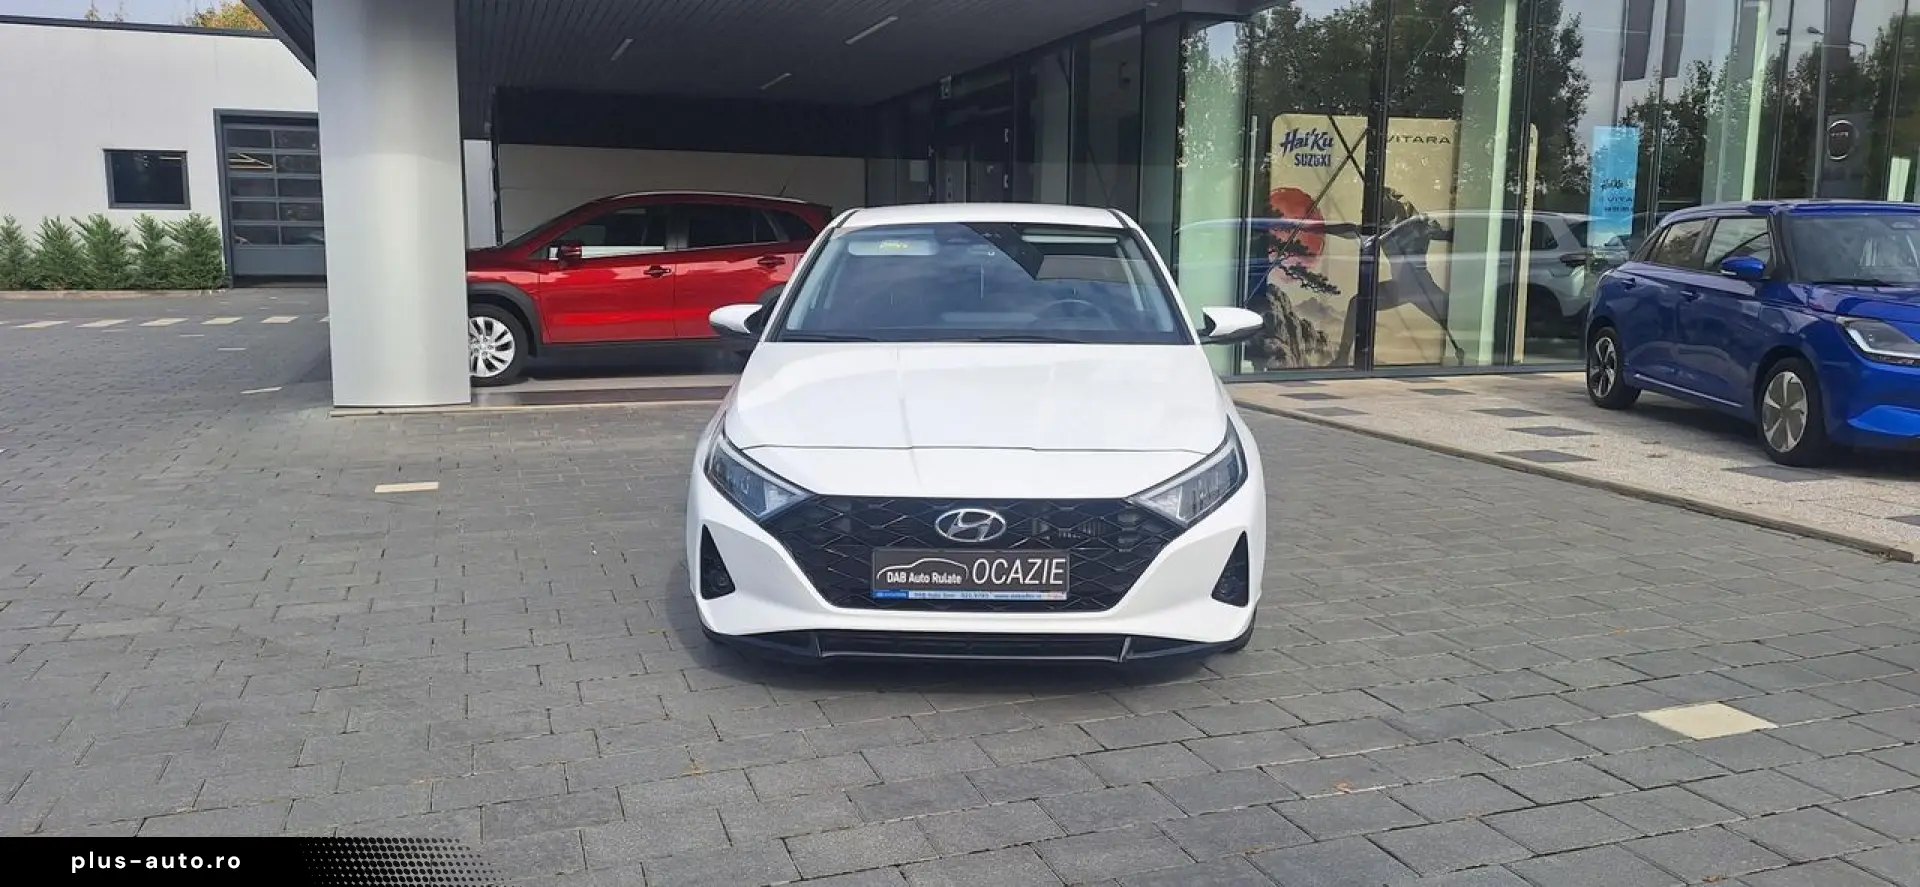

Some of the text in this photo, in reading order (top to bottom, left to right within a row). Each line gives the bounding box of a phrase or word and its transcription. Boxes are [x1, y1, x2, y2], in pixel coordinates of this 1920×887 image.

[886, 571, 962, 585] DAB Auto Rulate
[972, 557, 1067, 585] OCAZIE
